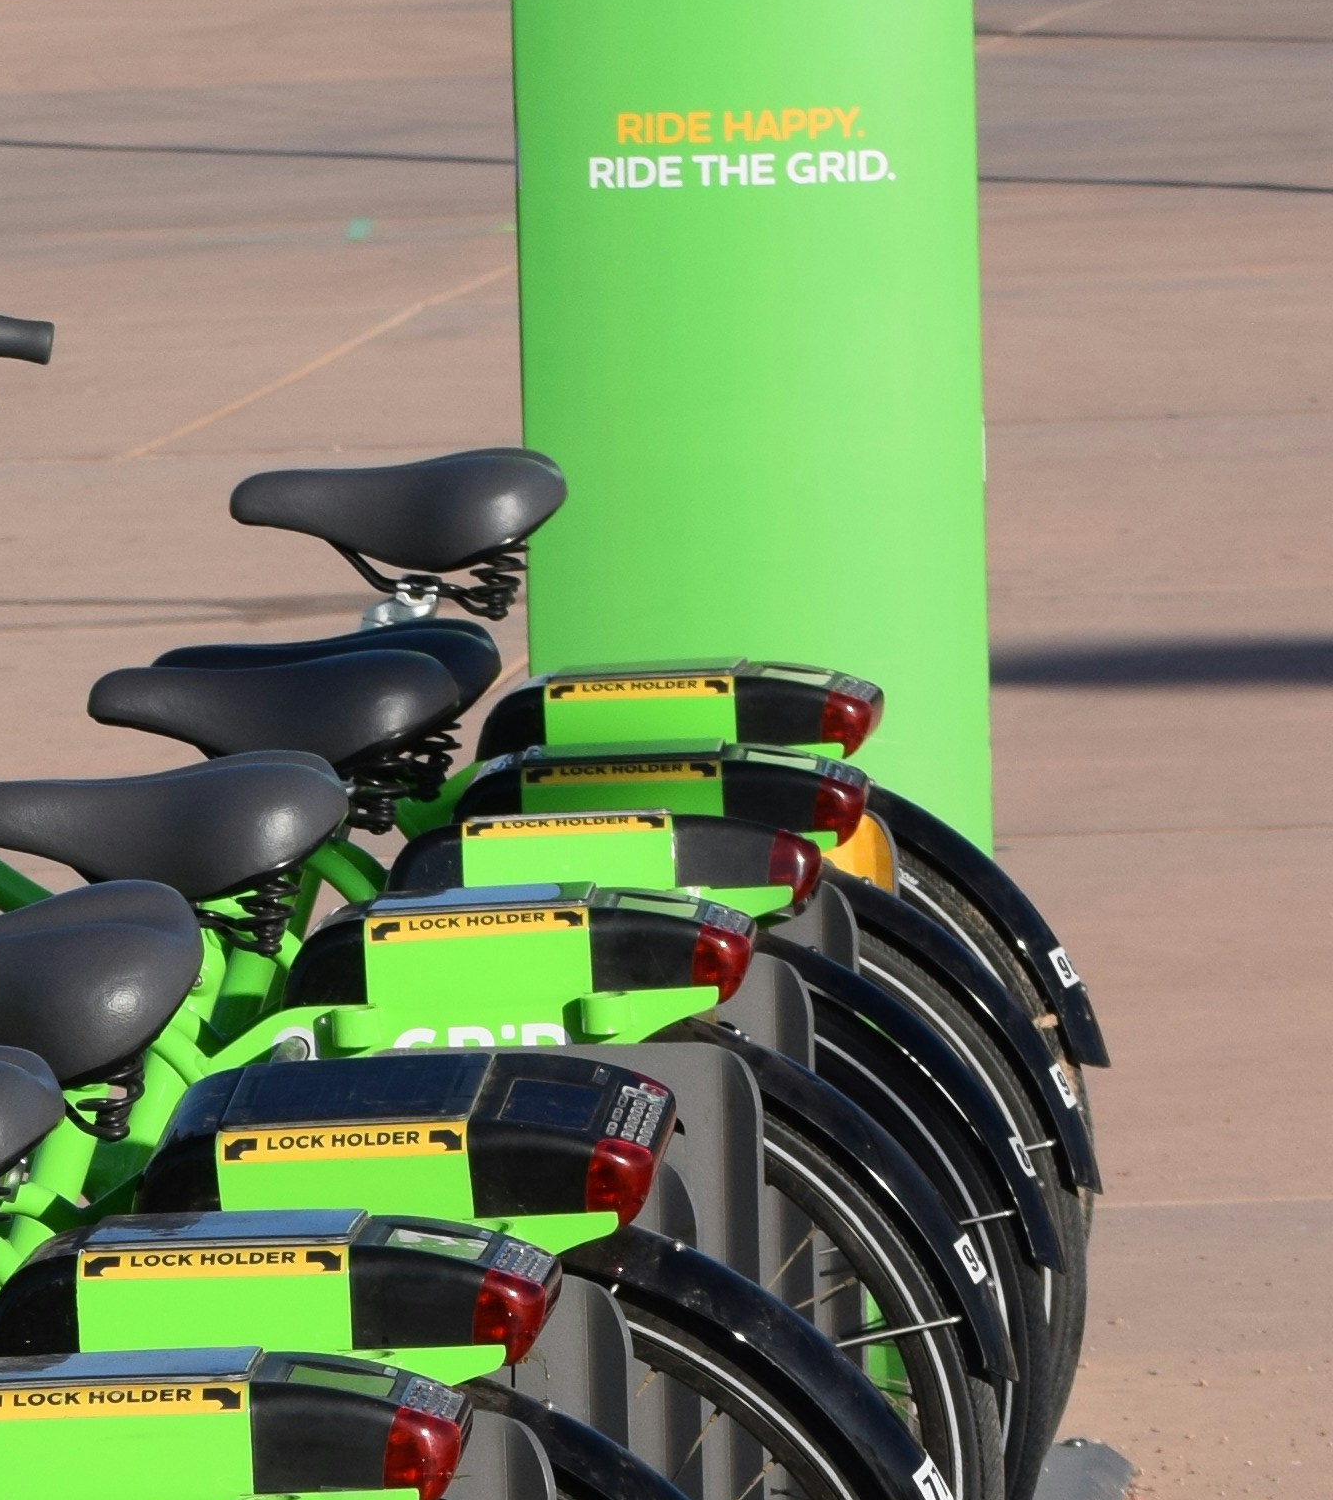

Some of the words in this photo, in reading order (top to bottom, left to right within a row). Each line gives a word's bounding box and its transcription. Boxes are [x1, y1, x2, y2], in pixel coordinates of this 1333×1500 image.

[616, 111, 712, 145] RIDE
[724, 107, 866, 143] HAPPY.
[588, 154, 682, 190] RIDE
[692, 152, 775, 187] THE
[786, 150, 897, 185] GRID.
[581, 682, 627, 695] LOCK
[630, 679, 699, 693] HOLDER
[560, 765, 608, 778] LOCK
[612, 761, 684, 776] HOLDER
[408, 916, 461, 931] LOCK
[466, 911, 546, 929] HOLDER
[267, 1134, 324, 1150] LOCK
[332, 1130, 421, 1149] HOLDER
[130, 1252, 193, 1269] LOCK
[200, 1248, 296, 1267] HOLDER
[13, 1390, 81, 1408] LOCK
[89, 1386, 193, 1406] HOLDER
